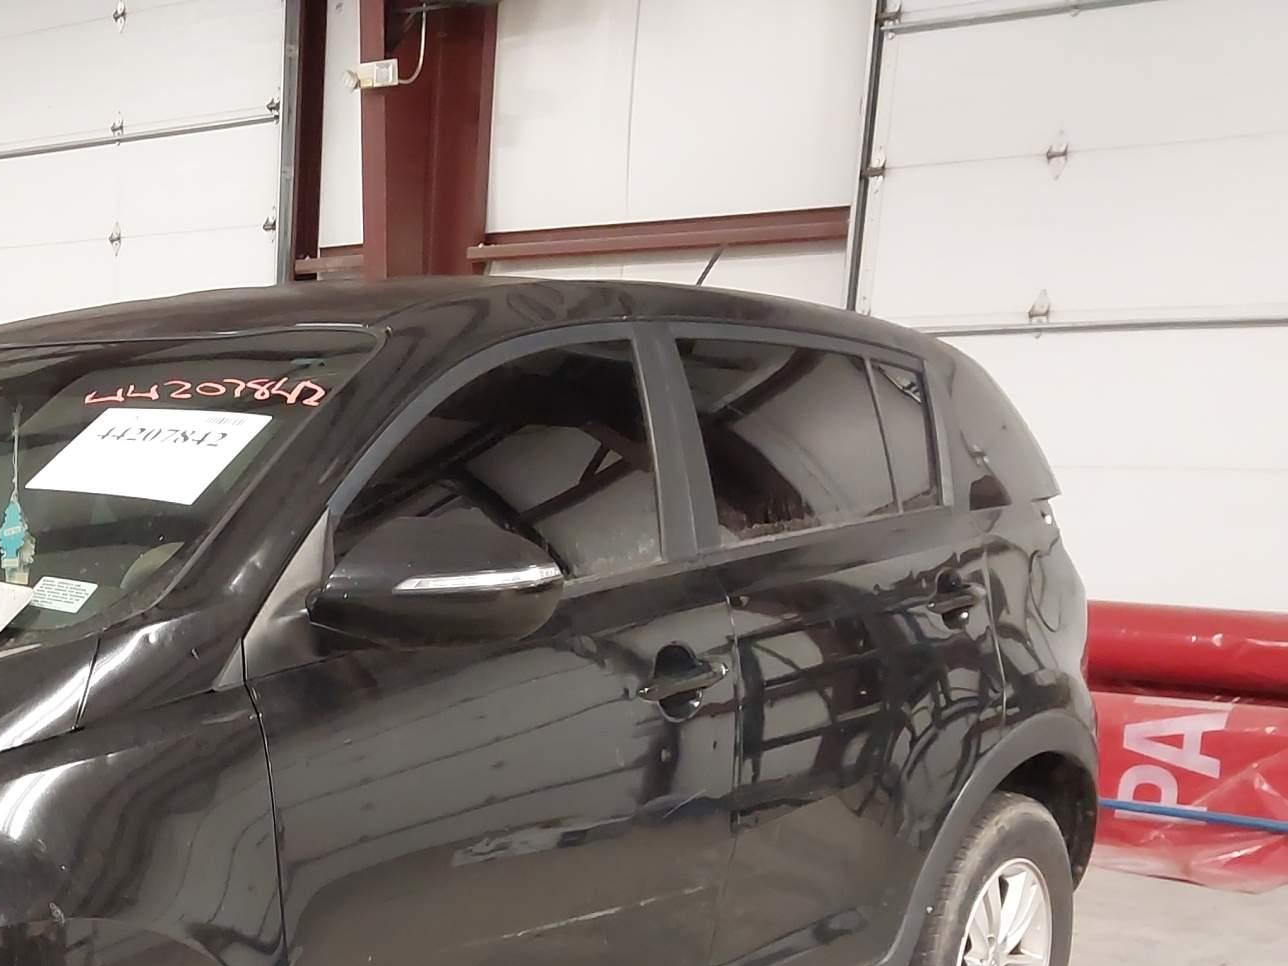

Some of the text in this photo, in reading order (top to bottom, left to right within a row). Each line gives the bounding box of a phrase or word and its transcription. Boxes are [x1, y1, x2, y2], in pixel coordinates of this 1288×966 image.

[85, 377, 326, 406] 44207842
[97, 427, 229, 447] 44207842
[1113, 696, 1234, 826] PA
